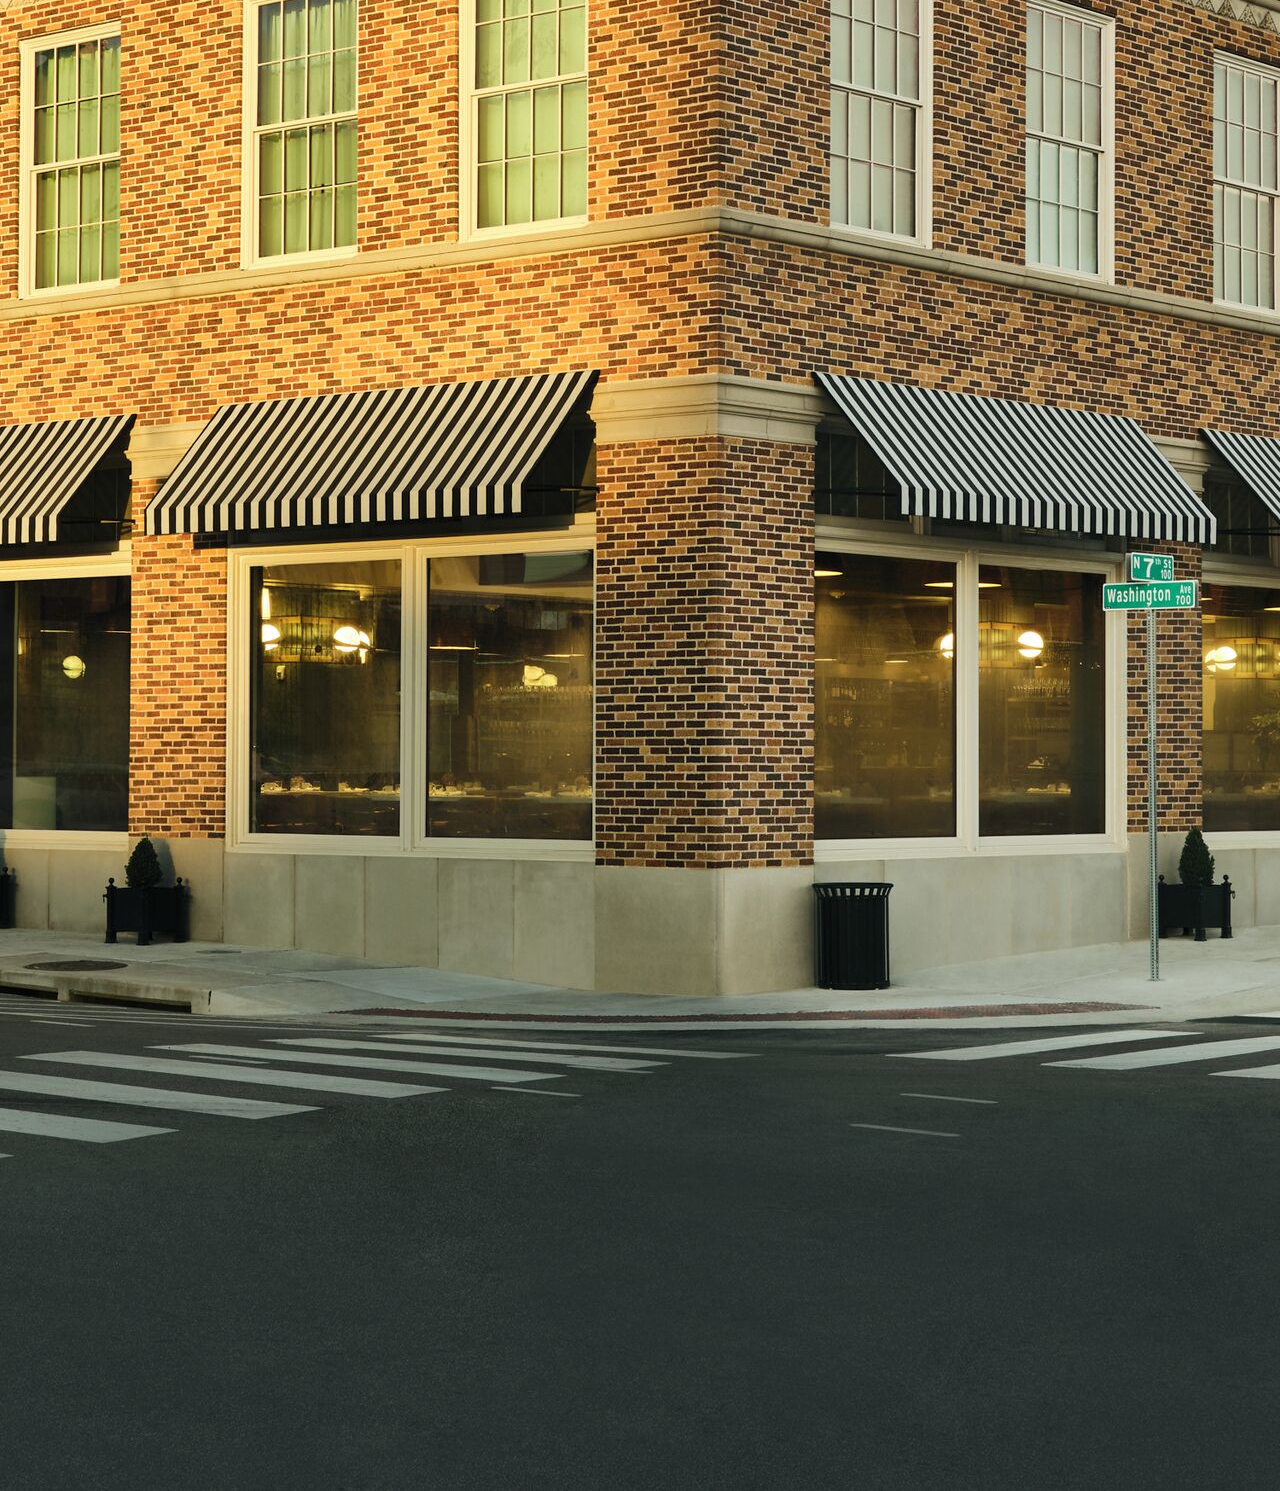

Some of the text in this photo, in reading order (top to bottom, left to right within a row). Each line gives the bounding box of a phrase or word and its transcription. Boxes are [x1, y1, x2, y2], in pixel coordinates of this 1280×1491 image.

[1133, 556, 1171, 578] N 7th St
[1161, 569, 1171, 579] 100
[1107, 585, 1191, 606] Washington Ave
[1175, 595, 1191, 605] 700
